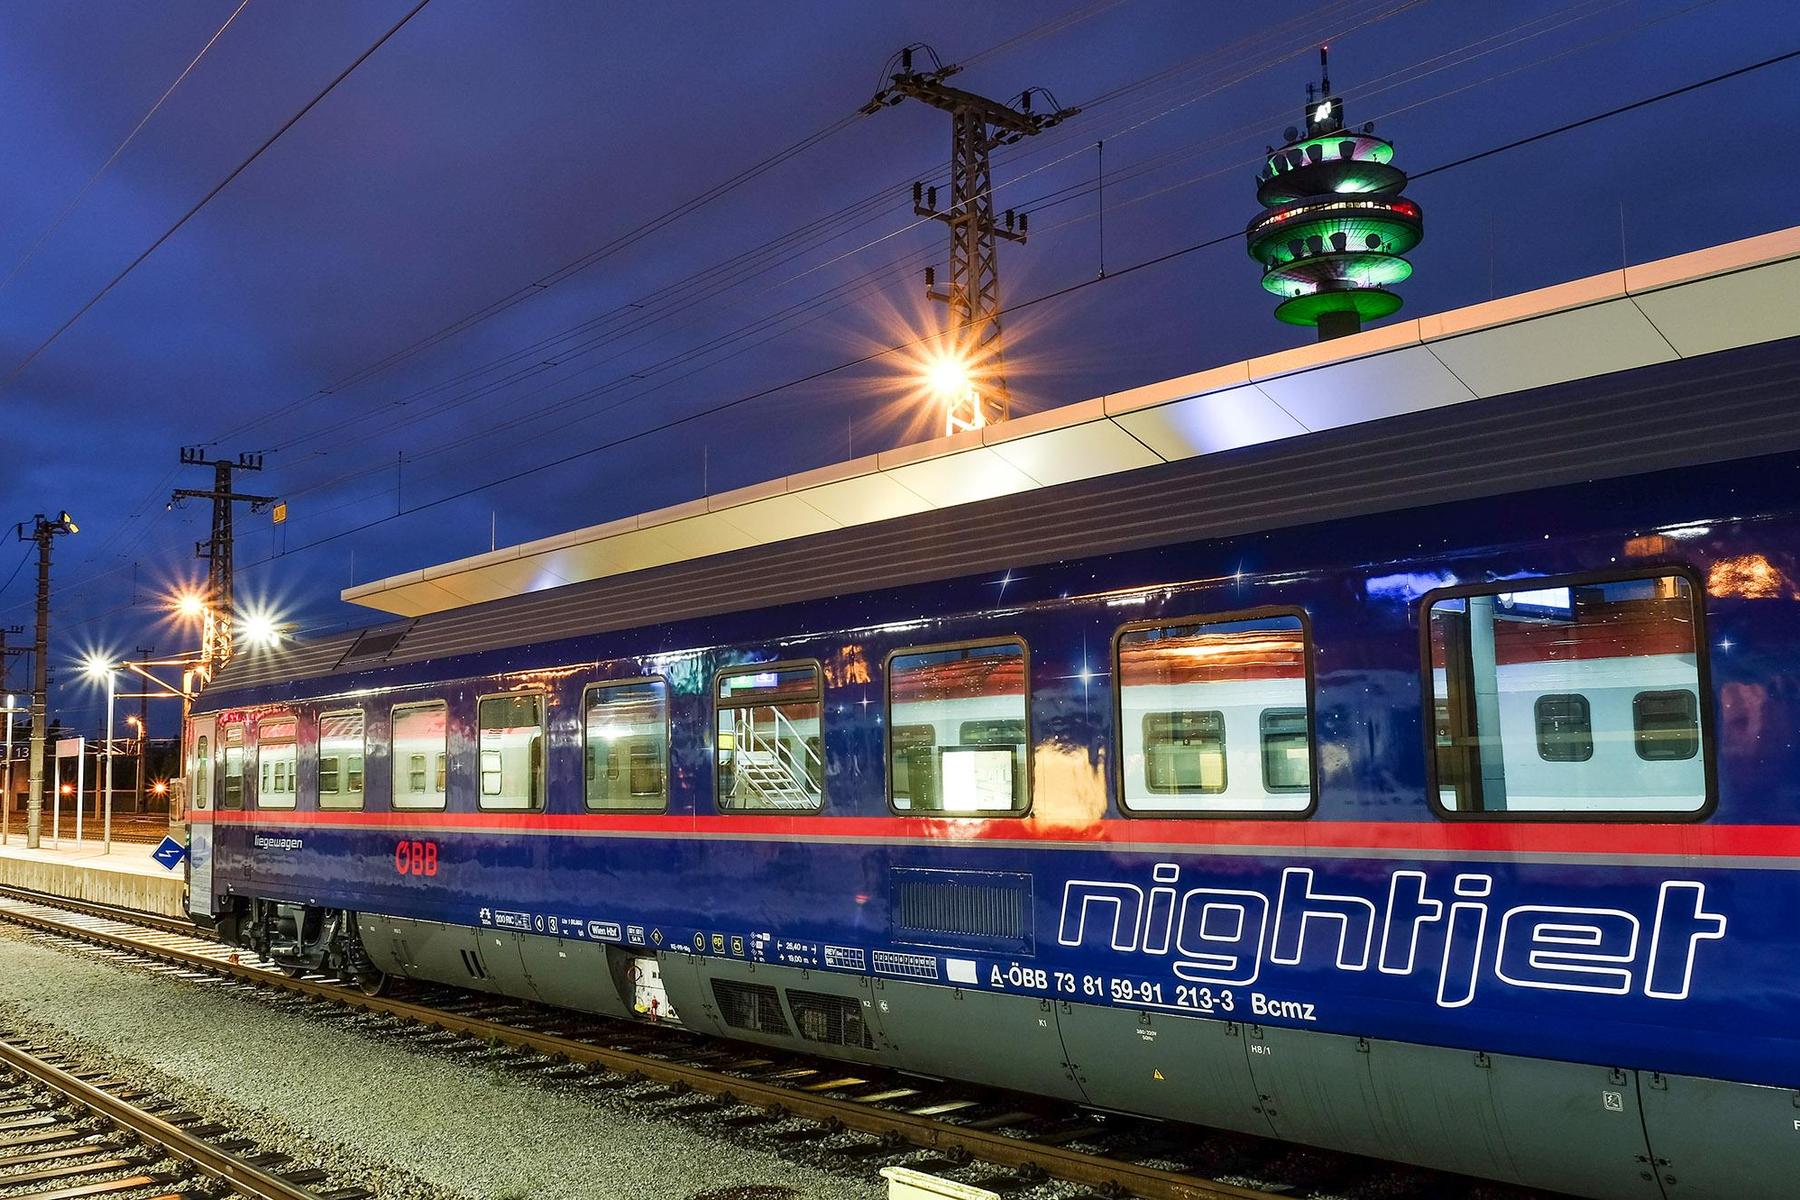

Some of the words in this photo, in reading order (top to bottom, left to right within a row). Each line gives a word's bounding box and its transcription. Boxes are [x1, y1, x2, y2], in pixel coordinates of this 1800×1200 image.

[15, 747, 30, 758] 13
[254, 834, 303, 850] liegewagen
[1057, 862, 1728, 1008] nightjet
[990, 962, 1048, 989] A-ÖBB
[1054, 972, 1076, 993] 73
[1083, 975, 1104, 996] 81
[1111, 978, 1163, 1003] 59-91
[1175, 985, 1235, 1011] 213-3
[1251, 992, 1317, 1021] Bcmz
[1038, 1019, 1047, 1027] K1
[1250, 1044, 1271, 1055] H8/1
